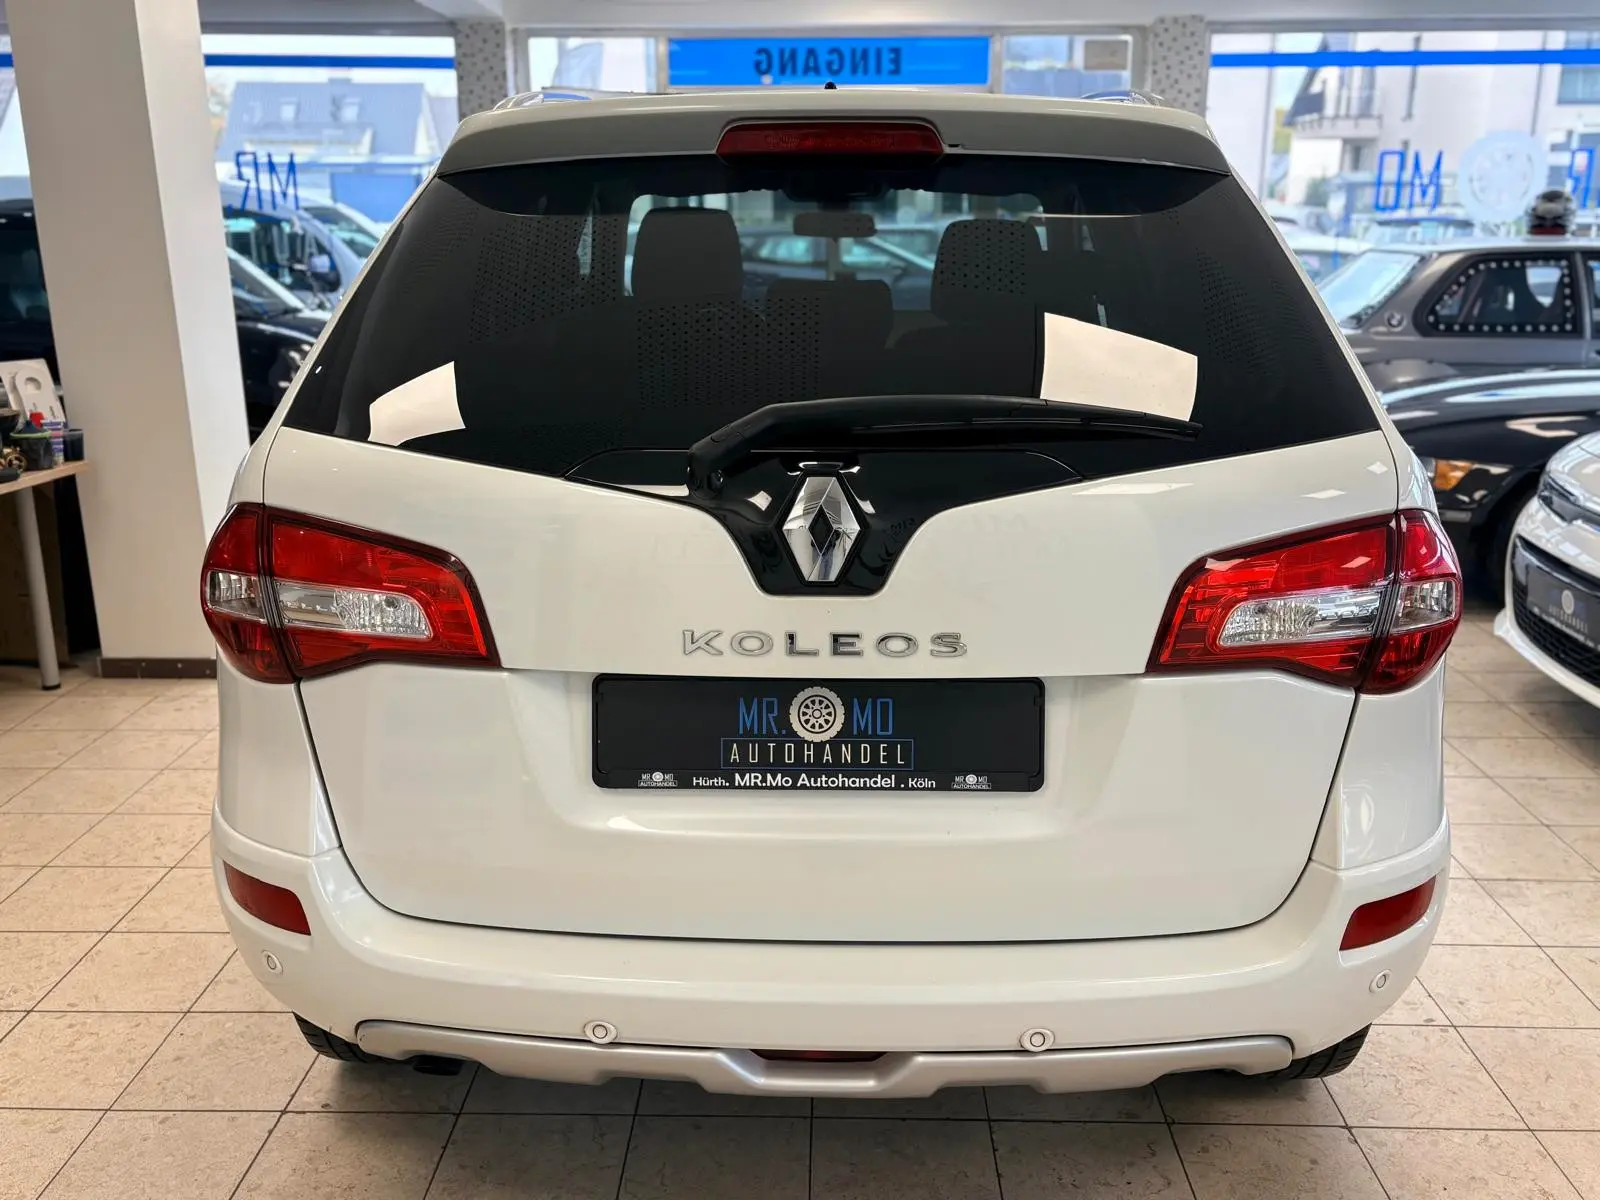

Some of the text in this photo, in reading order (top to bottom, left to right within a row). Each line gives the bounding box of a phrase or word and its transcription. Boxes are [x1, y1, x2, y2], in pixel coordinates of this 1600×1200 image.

[682, 630, 968, 657] KOLEOS
[738, 697, 893, 736] MR. MO
[730, 743, 905, 764] AUTOHANDEL
[692, 776, 730, 787] Hürth.
[734, 773, 792, 787] MR.Mo
[797, 773, 895, 788] Autohandel
[908, 777, 936, 788] Köln
